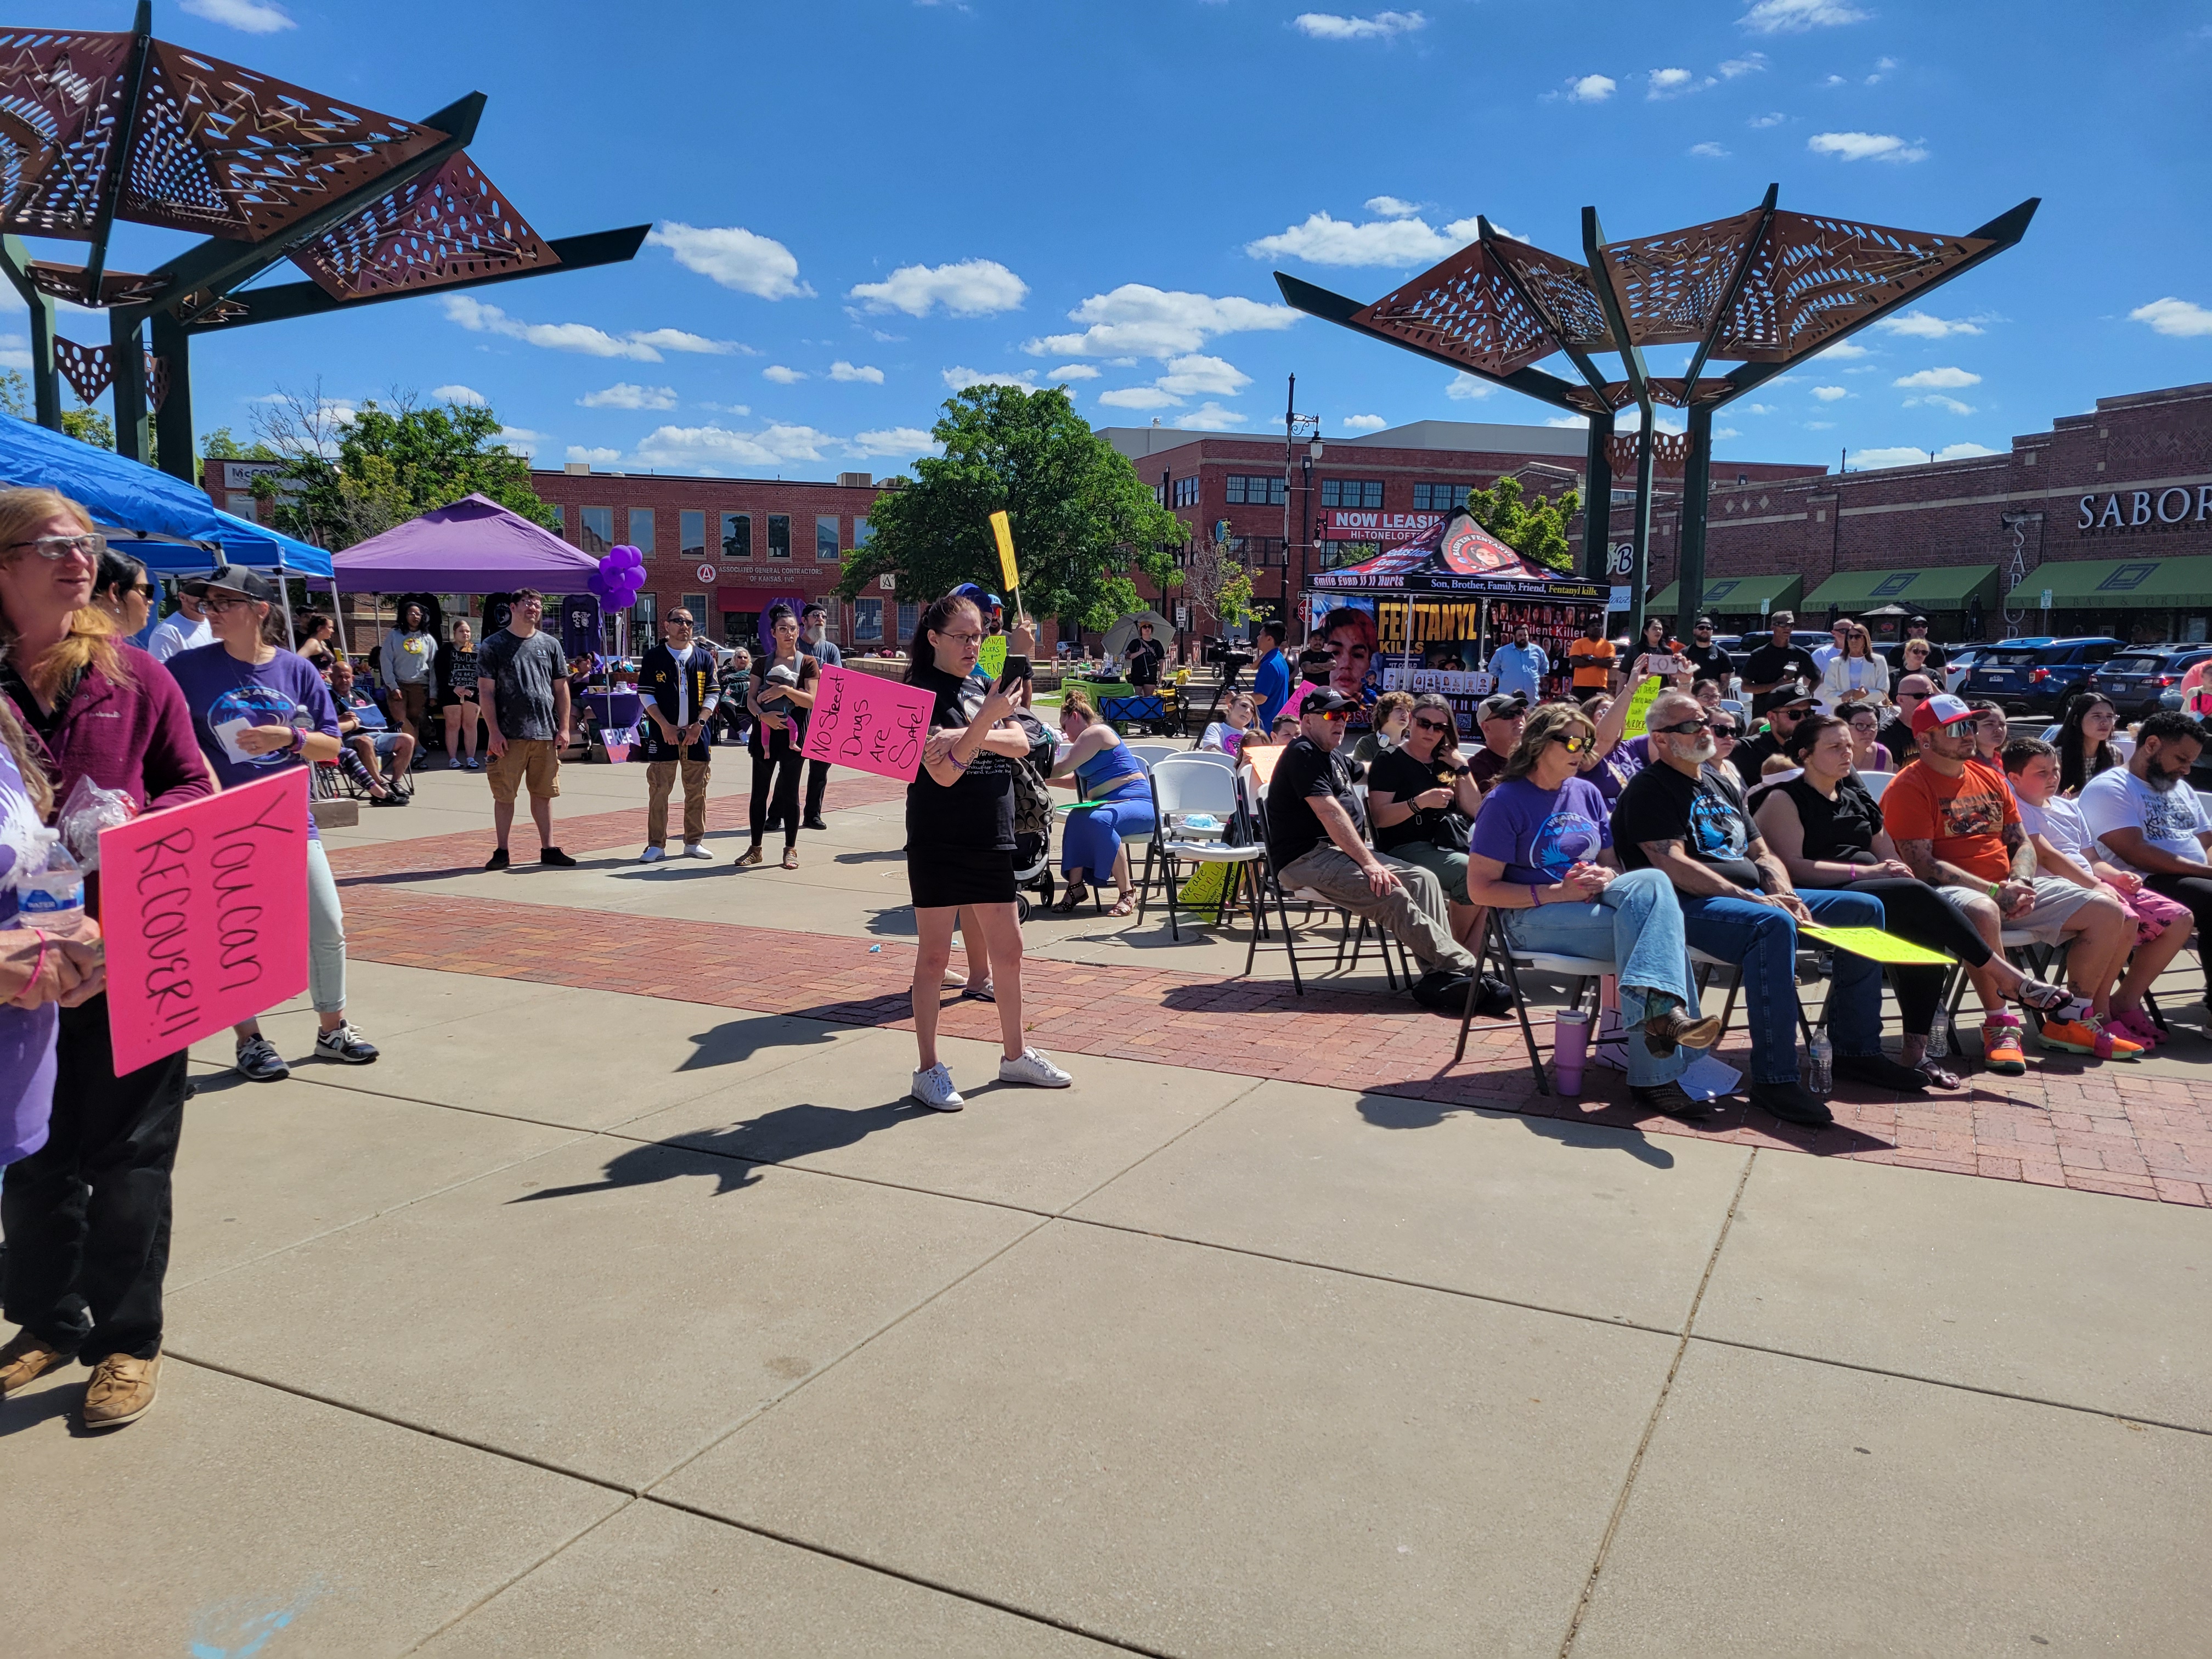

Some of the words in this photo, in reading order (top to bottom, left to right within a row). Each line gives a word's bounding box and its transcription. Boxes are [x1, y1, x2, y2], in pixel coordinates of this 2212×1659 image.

[1336, 512, 1378, 527] NOW
[1351, 530, 1420, 540] HI-TONELOFT
[1471, 534, 1513, 557] FENTANYL
[1378, 575, 1404, 586] Hurts
[1431, 579, 1449, 589] Son,
[1452, 579, 1486, 591] Brother,
[1487, 580, 1516, 592] Family,
[1518, 582, 1547, 594] Friend,
[1548, 584, 1580, 596] Fentanyl
[1581, 585, 1599, 596] kills.
[1378, 602, 1477, 641] FENTANYL
[1500, 621, 1514, 632] Th
[1529, 623, 1553, 636] ilent
[1555, 625, 1585, 638] Killer
[252, 689, 280, 699] ARE
[840, 699, 872, 759] Drugs
[1544, 822, 1592, 837] APALD
[1178, 887, 1193, 901] We
[1192, 869, 1207, 887] are
